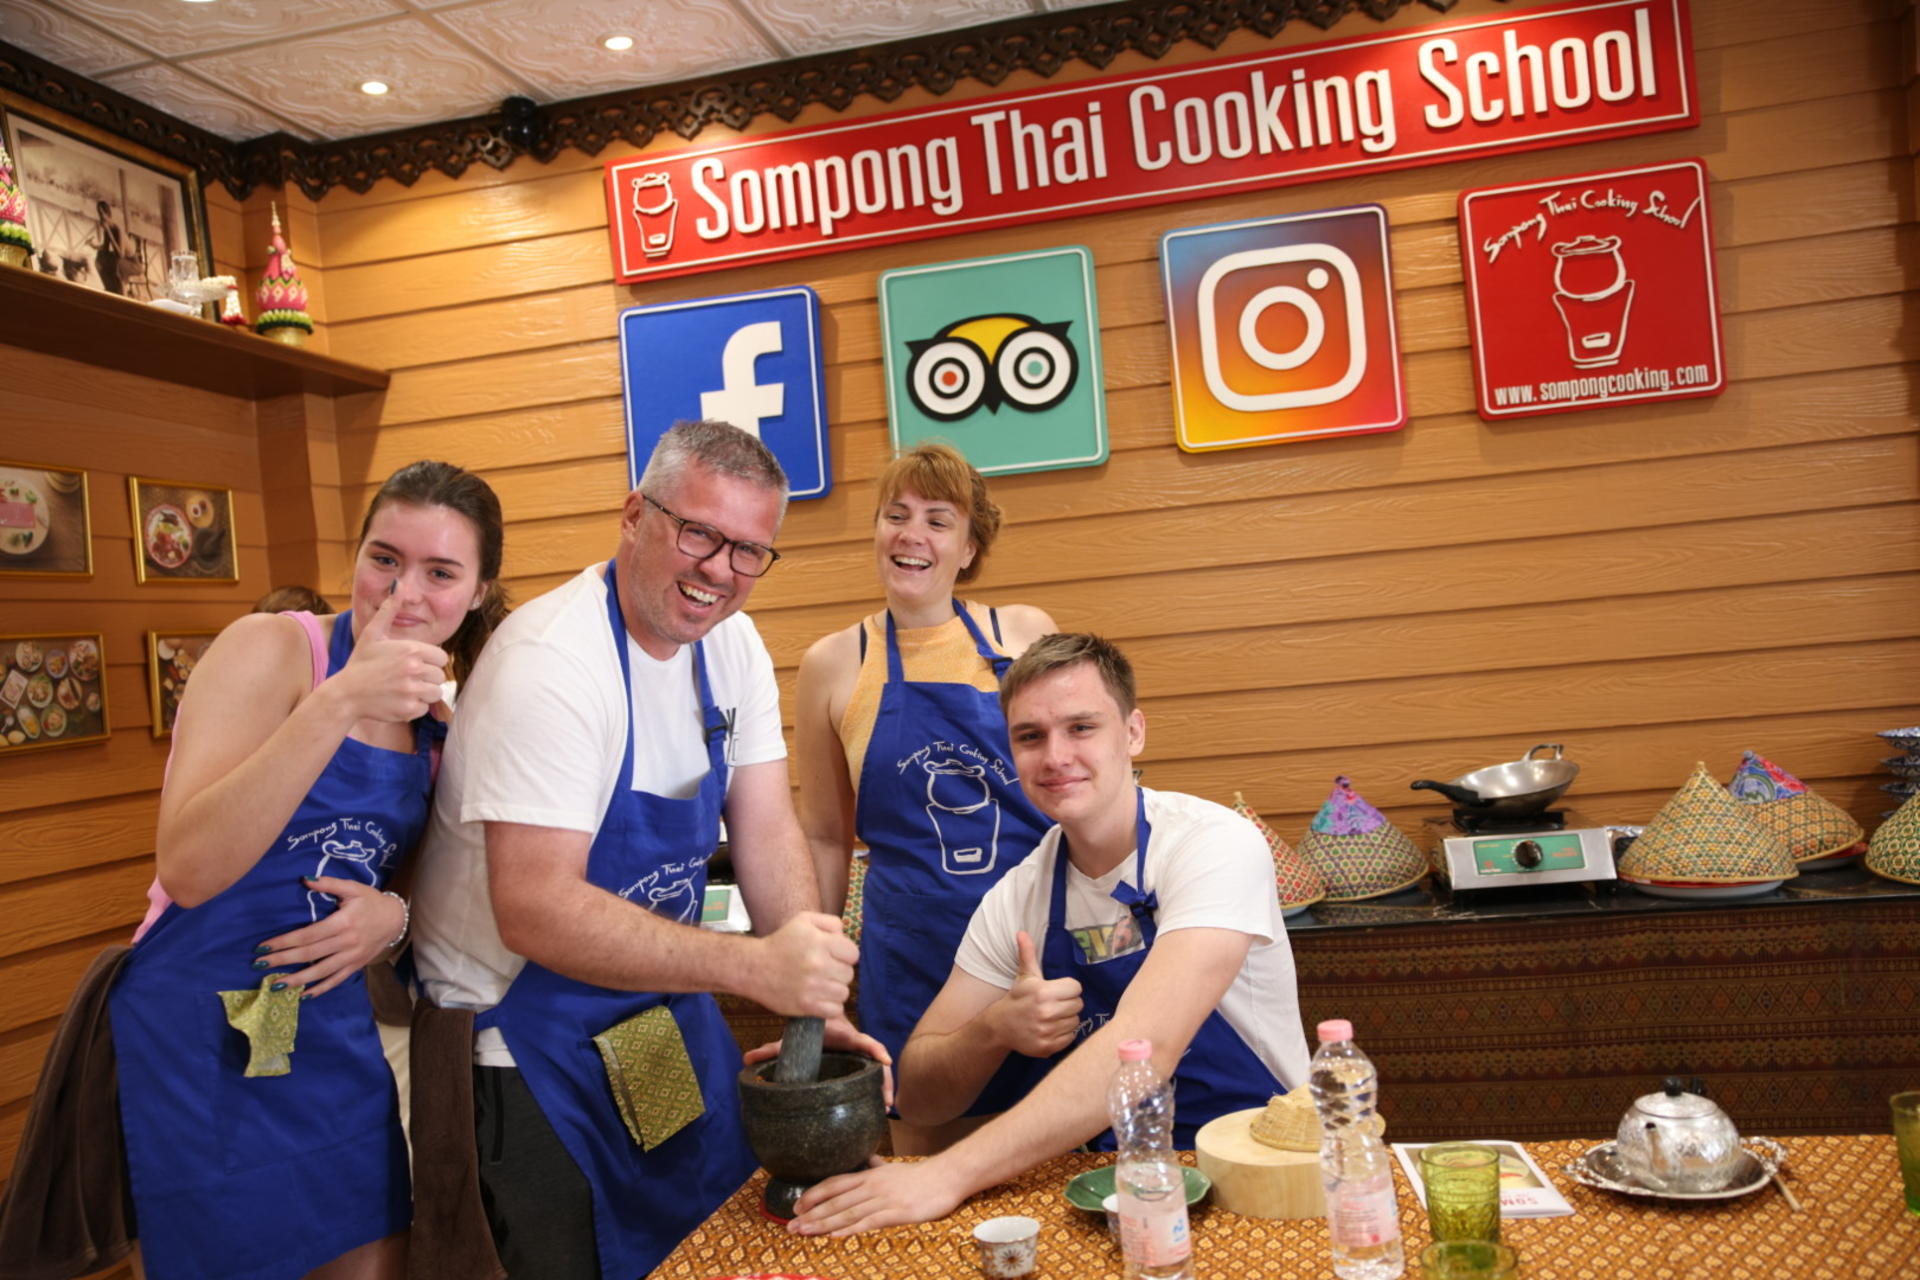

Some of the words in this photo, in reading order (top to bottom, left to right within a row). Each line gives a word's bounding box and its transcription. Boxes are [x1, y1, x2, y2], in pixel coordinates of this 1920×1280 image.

[691, 137, 963, 237] Sompong
[971, 102, 1107, 195] Thai
[1128, 69, 1397, 170] Cooking
[1418, 8, 1657, 128] School
[1484, 213, 1547, 263] Sompong
[1540, 191, 1577, 216] Thai
[1582, 189, 1638, 217] Cooking
[1643, 190, 1701, 228] School
